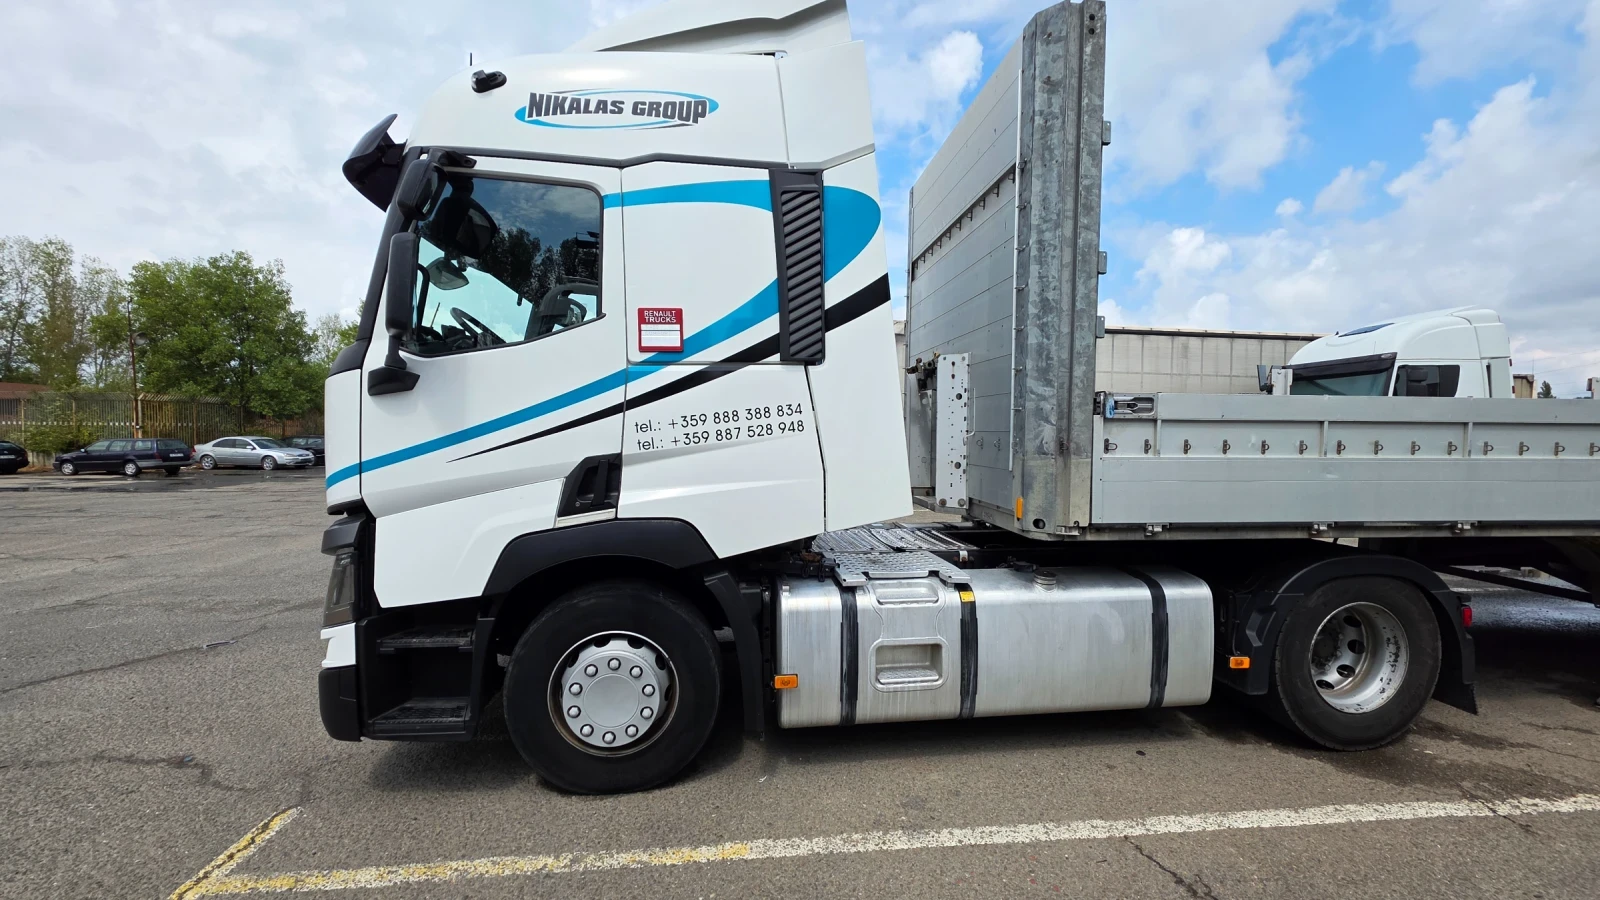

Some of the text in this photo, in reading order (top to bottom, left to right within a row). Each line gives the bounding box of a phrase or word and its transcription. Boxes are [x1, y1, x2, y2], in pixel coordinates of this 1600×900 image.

[527, 92, 708, 124] NIKALAS GROUP
[634, 403, 803, 433] tel.: +359 888 388 834
[637, 420, 805, 451] tel.: +359 887 528 948
